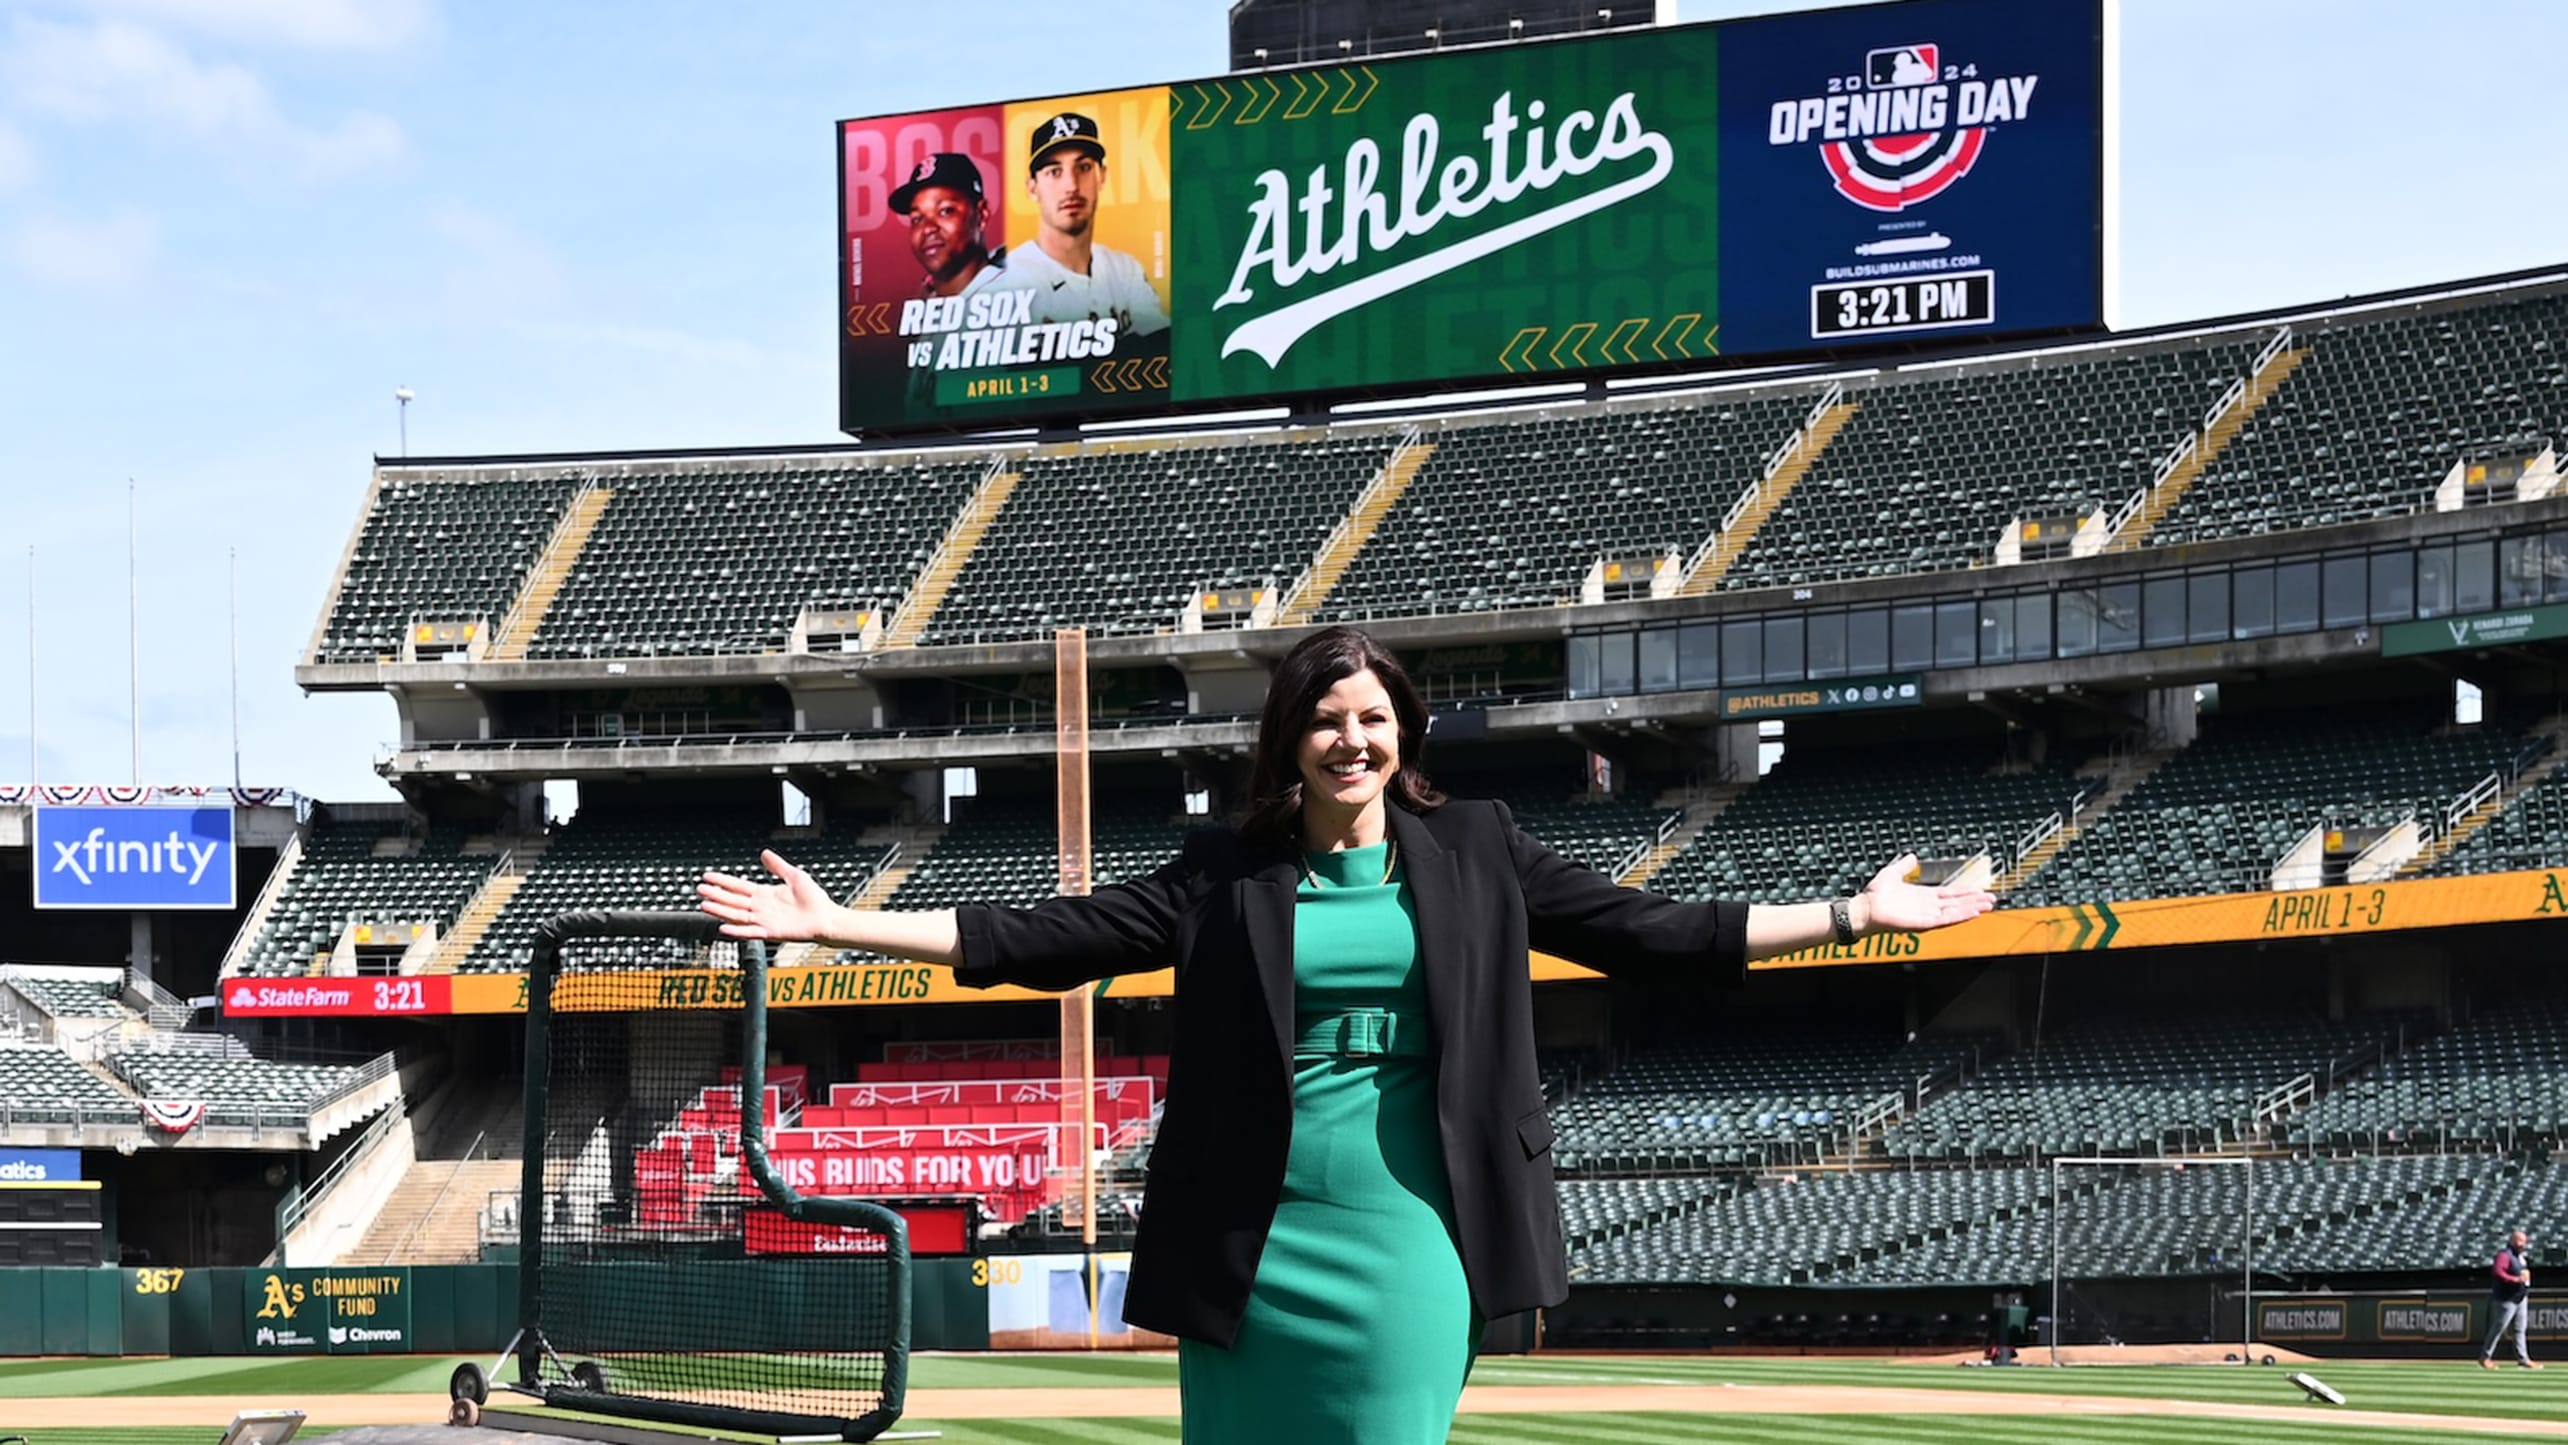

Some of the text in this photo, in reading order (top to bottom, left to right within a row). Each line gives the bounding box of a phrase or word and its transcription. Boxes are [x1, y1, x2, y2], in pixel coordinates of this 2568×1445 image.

[1828, 63, 1979, 93] 20 24
[1769, 75, 2039, 145] OPENING DAY
[1213, 91, 1650, 313] Athletics
[1826, 255, 1981, 280] BUILDSUBMARINES.COM
[899, 295, 966, 336] RED
[967, 288, 1036, 329] SOX
[1838, 280, 1968, 328] 3:21 PM
[907, 341, 933, 368] VS
[935, 317, 1118, 371] ATHLETICS
[967, 374, 1049, 398] APRIL 1-3
[1728, 691, 1820, 713] @ATHLETICS
[53, 827, 218, 885] xfinity
[2261, 888, 2386, 932] APRIL 1-3
[374, 981, 426, 1010] 3:21
[770, 977, 796, 1002] VS
[800, 968, 931, 1001] ATHLETICS
[914, 1155, 972, 1187] FOR
[135, 1268, 185, 1295] 367
[312, 1276, 400, 1297] COMMUNITY
[971, 1259, 1022, 1287] 330
[256, 1274, 305, 1319] A's
[337, 1298, 376, 1316] FUND
[349, 1327, 402, 1342] Chevron
[2264, 1310, 2341, 1330] ATHLETICS.COM
[2384, 1310, 2464, 1332] ATHLETICS.COM
